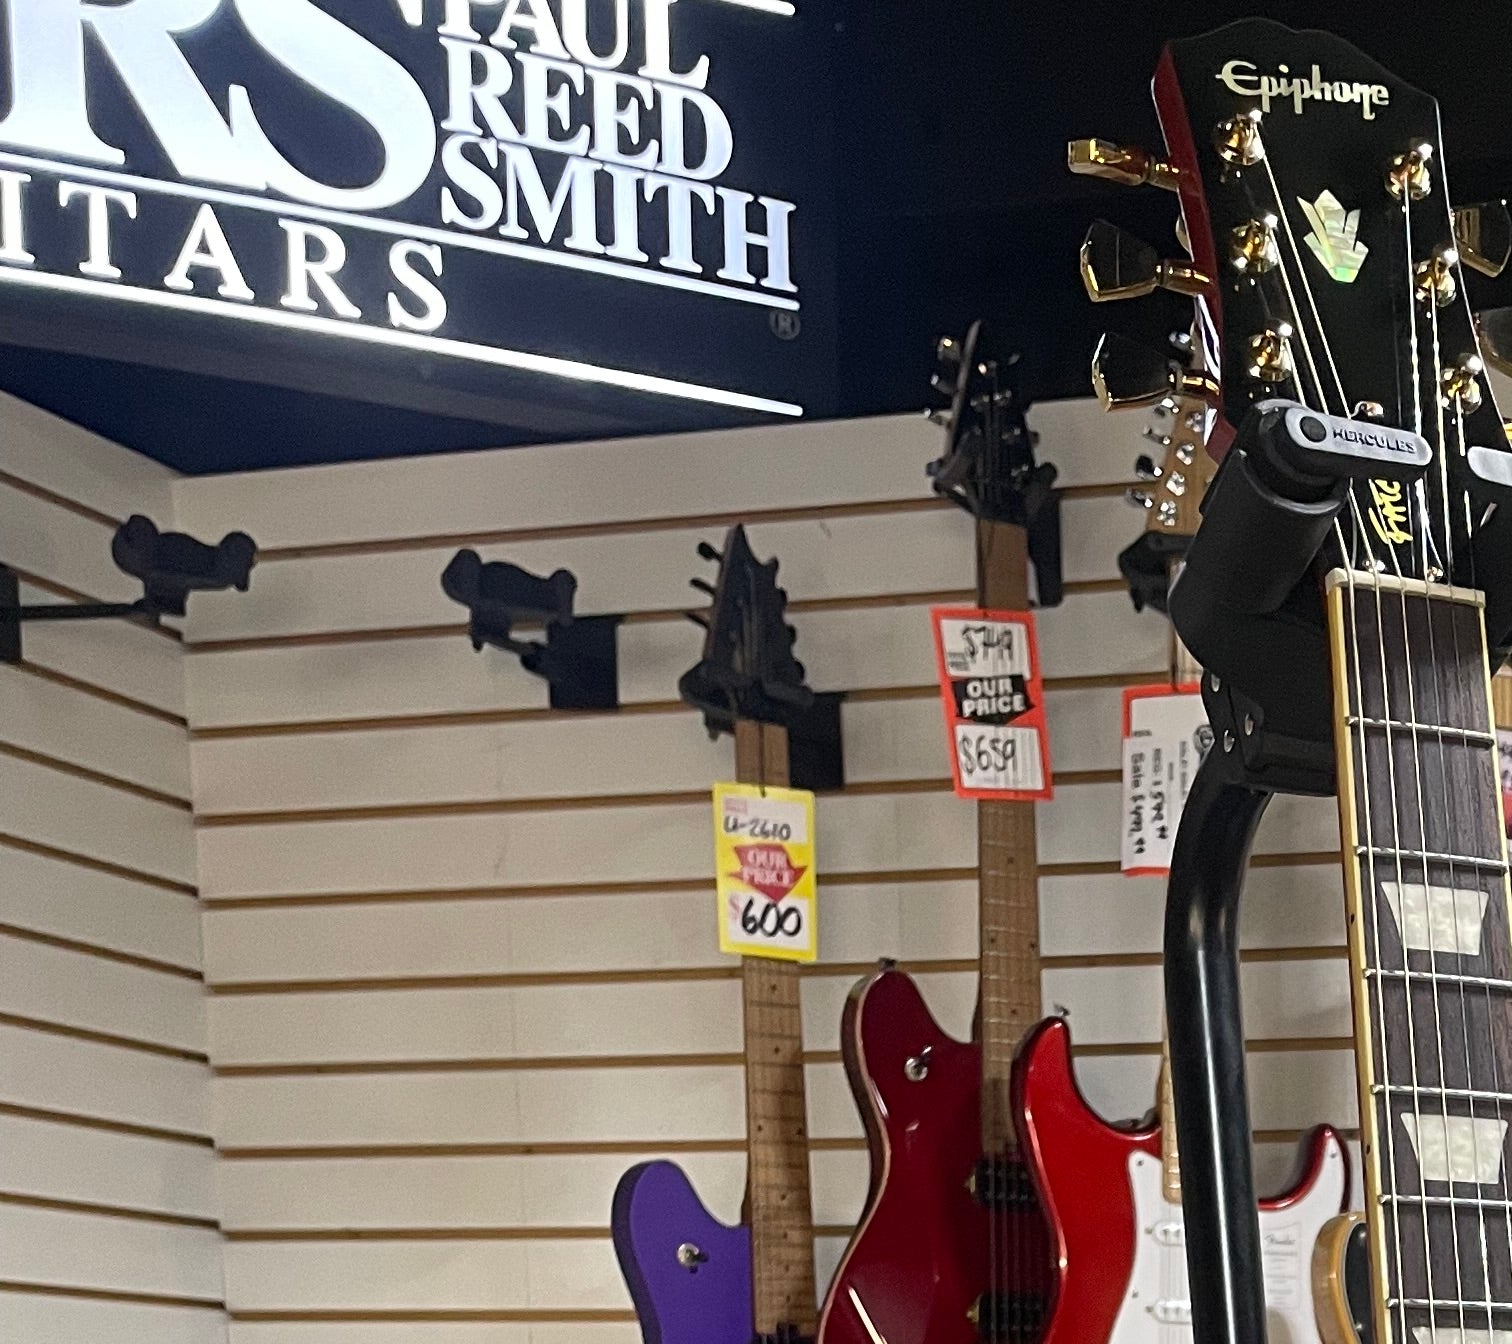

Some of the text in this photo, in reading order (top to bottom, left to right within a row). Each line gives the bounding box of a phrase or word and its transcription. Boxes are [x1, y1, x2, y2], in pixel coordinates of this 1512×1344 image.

[438, 36, 734, 181] REED
[1215, 60, 1390, 121] Epiphone
[441, 133, 799, 293] SMITH
[1332, 427, 1416, 455] HERCULES
[961, 694, 1027, 719] PRICE
[966, 678, 1014, 700] OUR
